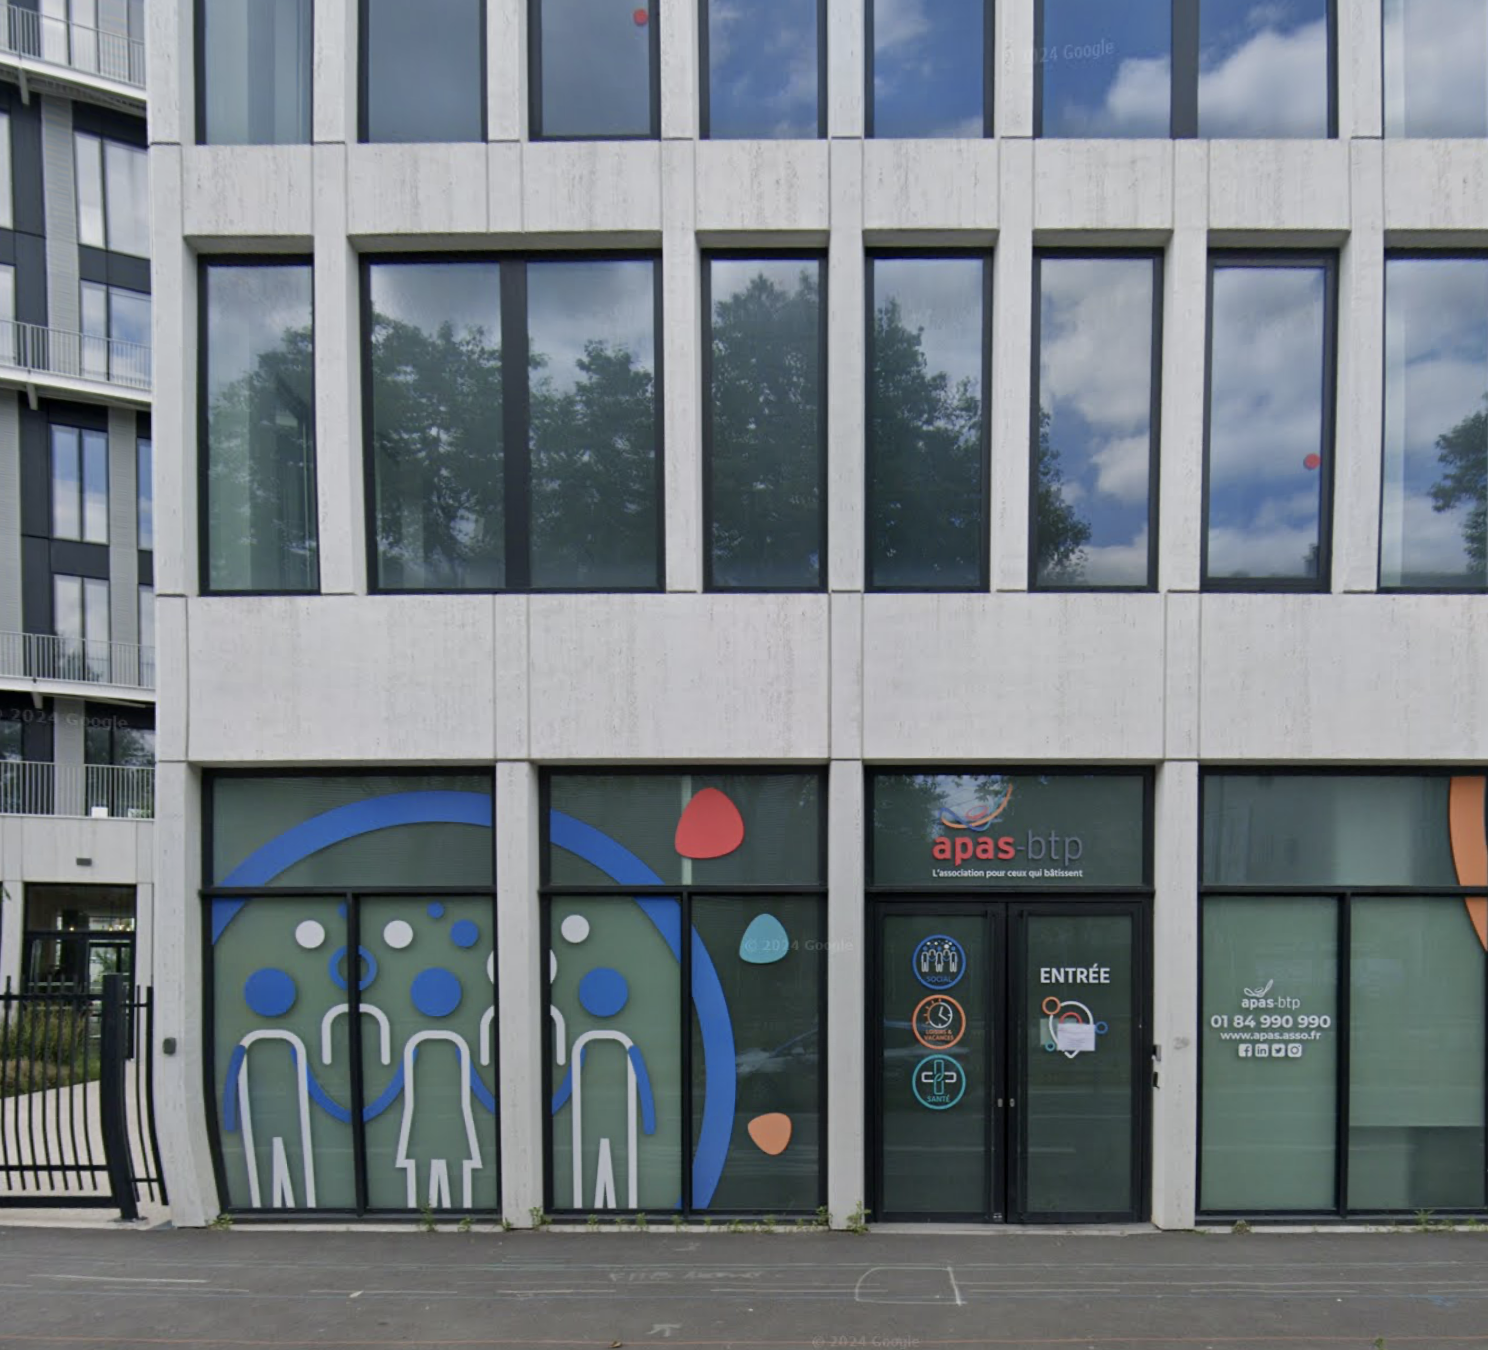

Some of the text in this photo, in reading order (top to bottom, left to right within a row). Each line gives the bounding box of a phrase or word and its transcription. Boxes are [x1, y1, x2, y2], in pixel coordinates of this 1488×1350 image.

[931, 829, 1083, 866] apas-btp
[932, 868, 1083, 879] L'association pour ceux qui bâtissent
[926, 975, 952, 983] SOCIAL
[1040, 963, 1110, 984] ENTRÉE
[1241, 996, 1301, 1010] apas-btp
[1210, 1015, 1331, 1028] 01 84 990 990
[1220, 1031, 1321, 1041] www.apas.asso.fr
